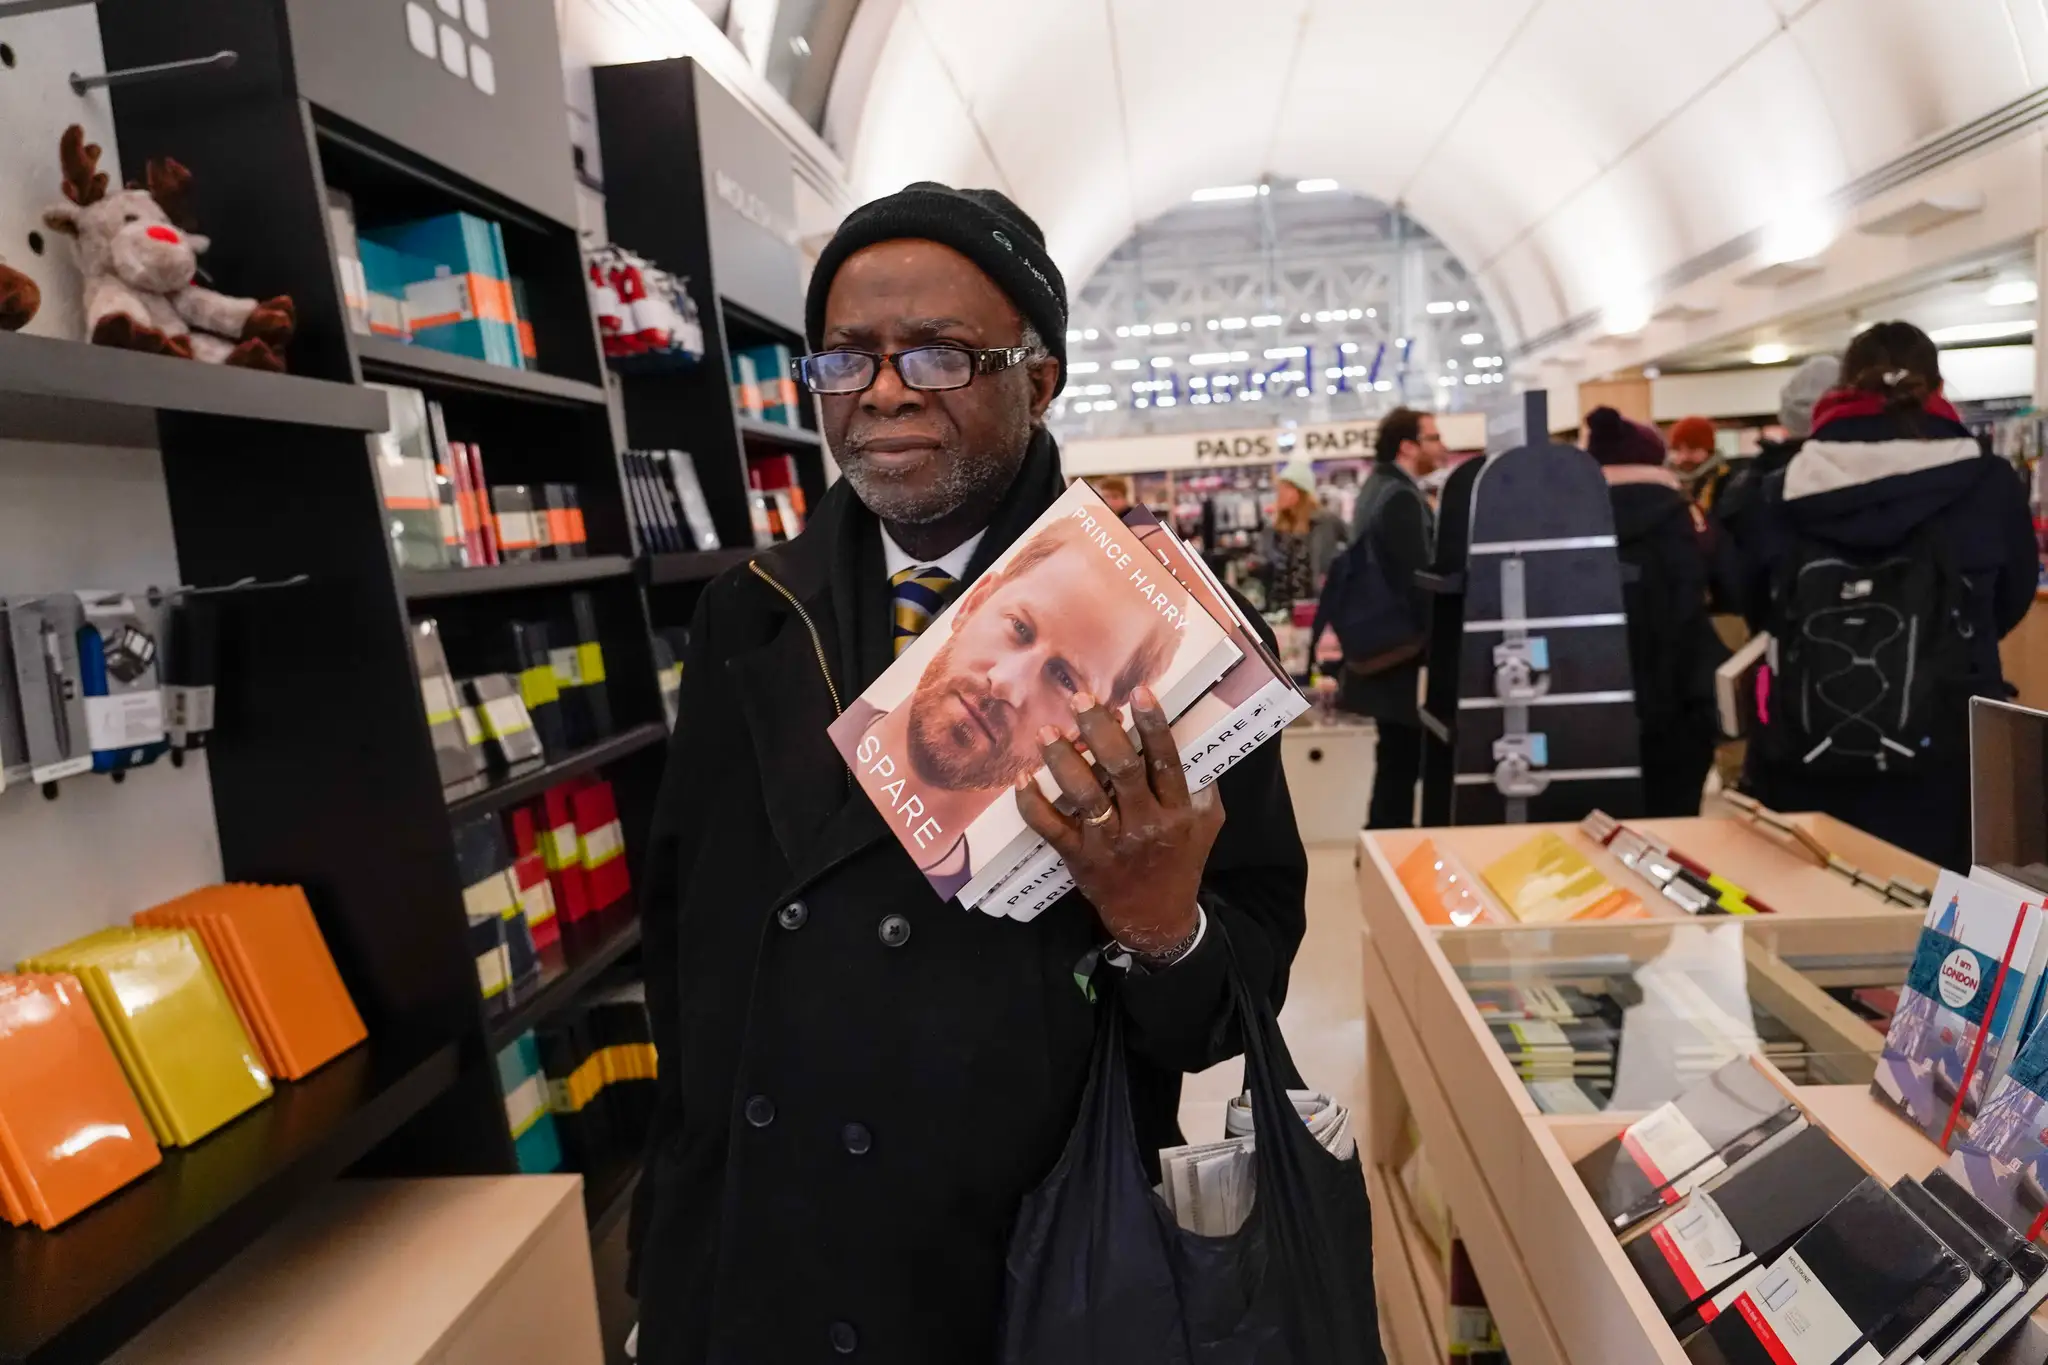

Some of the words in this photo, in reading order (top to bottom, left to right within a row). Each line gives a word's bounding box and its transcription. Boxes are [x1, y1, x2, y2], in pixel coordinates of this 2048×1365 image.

[1196, 435, 1272, 460] PADS
[1072, 506, 1132, 571] PRINCE
[1129, 568, 1190, 631] HARRY
[1182, 719, 1248, 773] SPARE
[1199, 730, 1268, 785] SPARE
[856, 735, 943, 850] SPARE
[1941, 964, 1978, 991] LONDON
[1955, 954, 1960, 965] I
[1960, 960, 1972, 971] am
